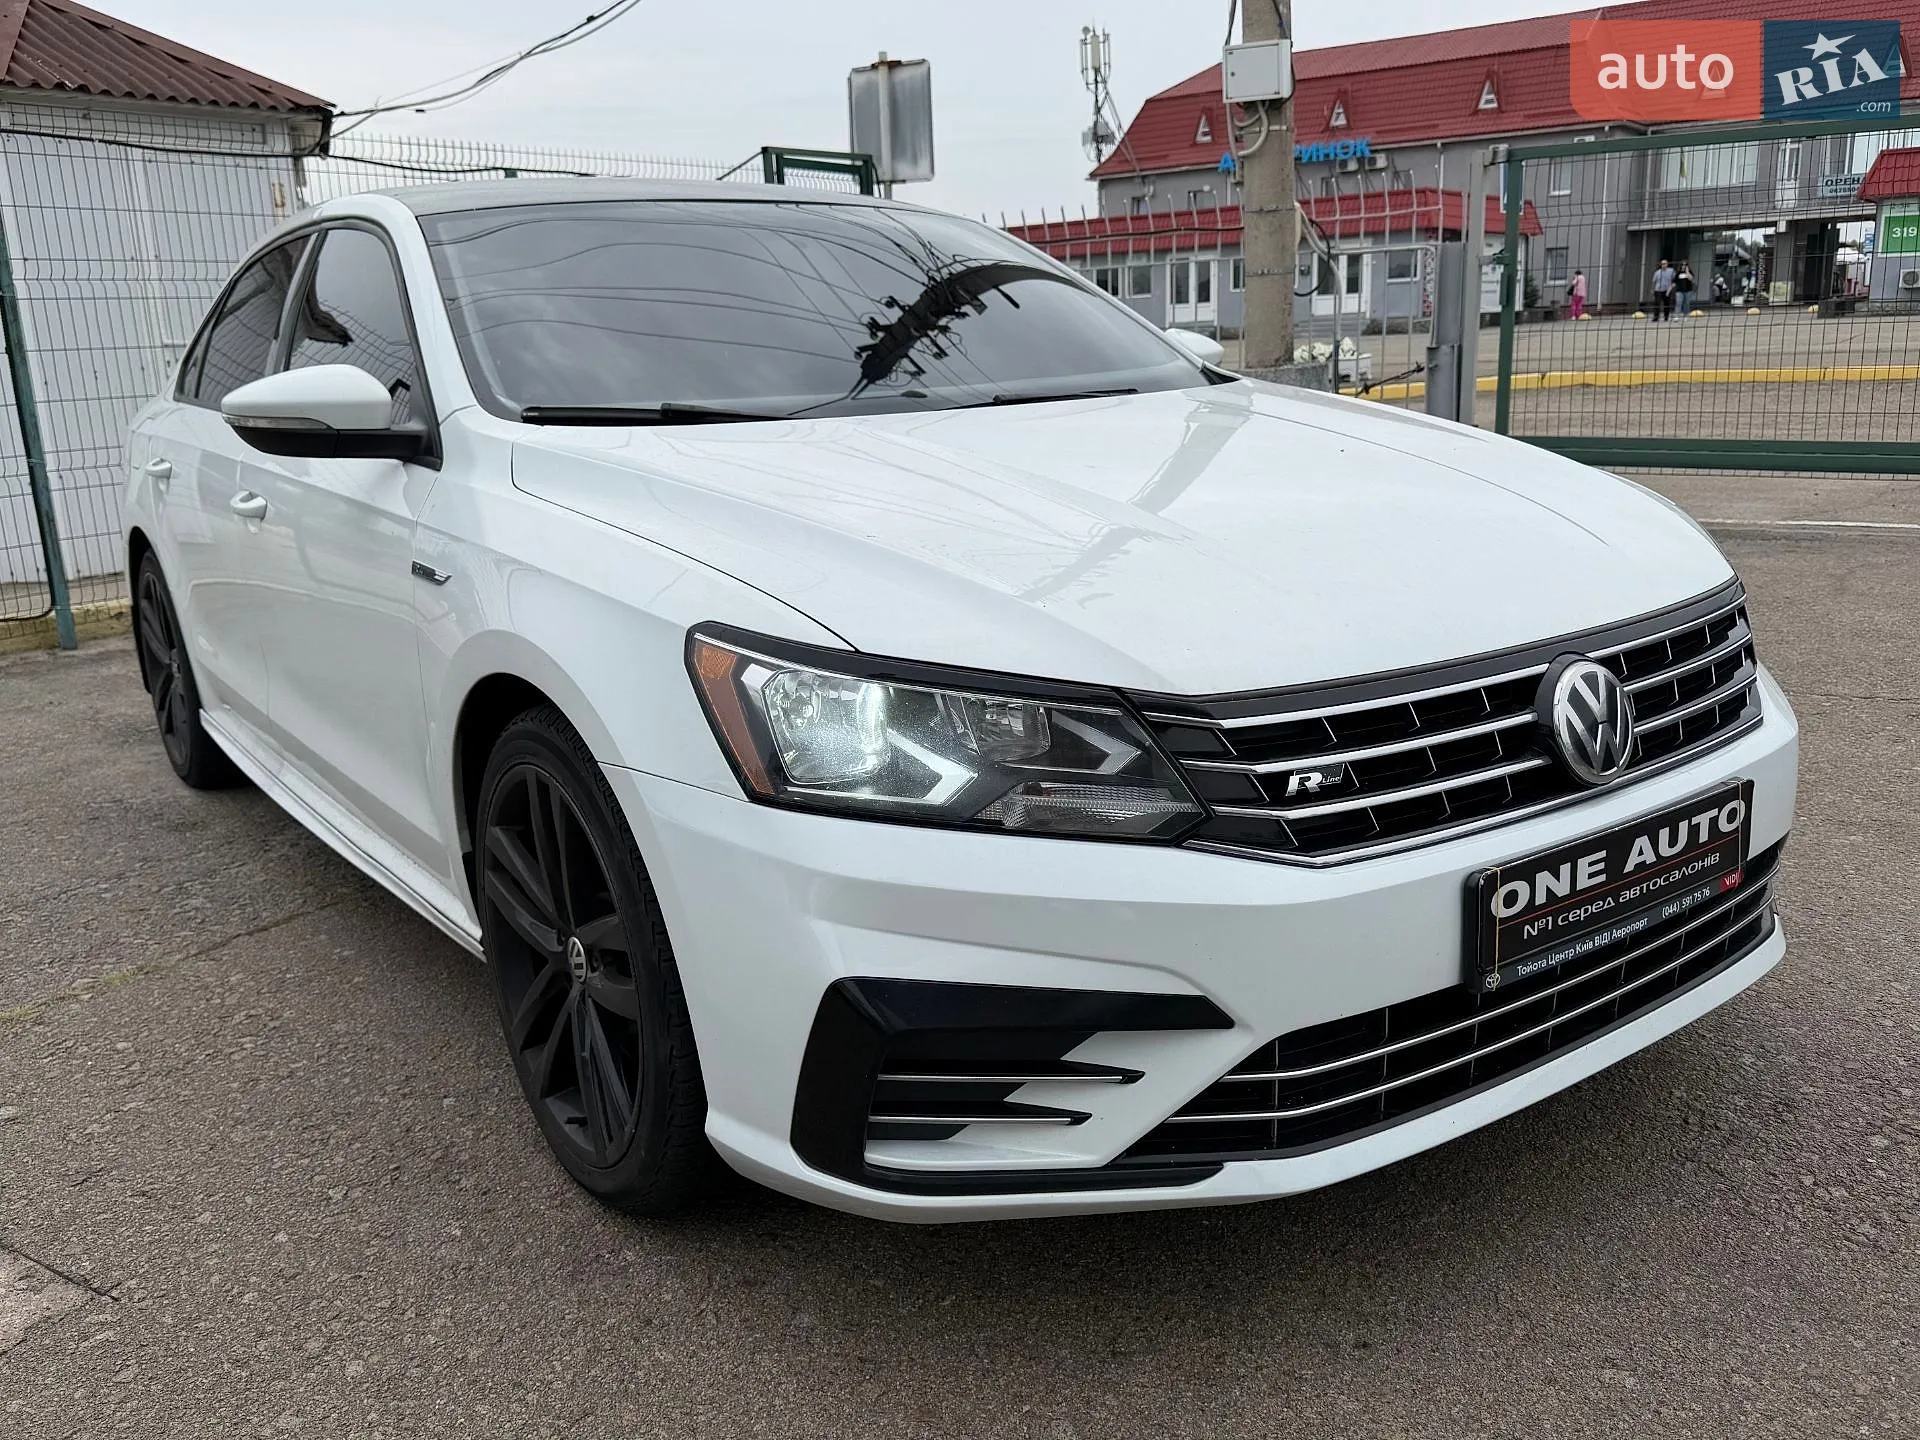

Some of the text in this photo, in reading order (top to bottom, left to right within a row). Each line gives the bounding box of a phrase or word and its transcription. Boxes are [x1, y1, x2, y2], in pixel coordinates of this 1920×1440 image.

[1825, 176, 1863, 188] ОРЕН
[1892, 226, 1918, 238] 319
[1490, 799, 1746, 918] ONE AUTO
[1558, 897, 1616, 926] серед
[1619, 852, 1720, 903] автосалонів
[1662, 901, 1680, 919] (044)
[1517, 958, 1547, 977] Тойота
[1548, 947, 1575, 965] Центр
[1612, 917, 1649, 941] Аеропорт
